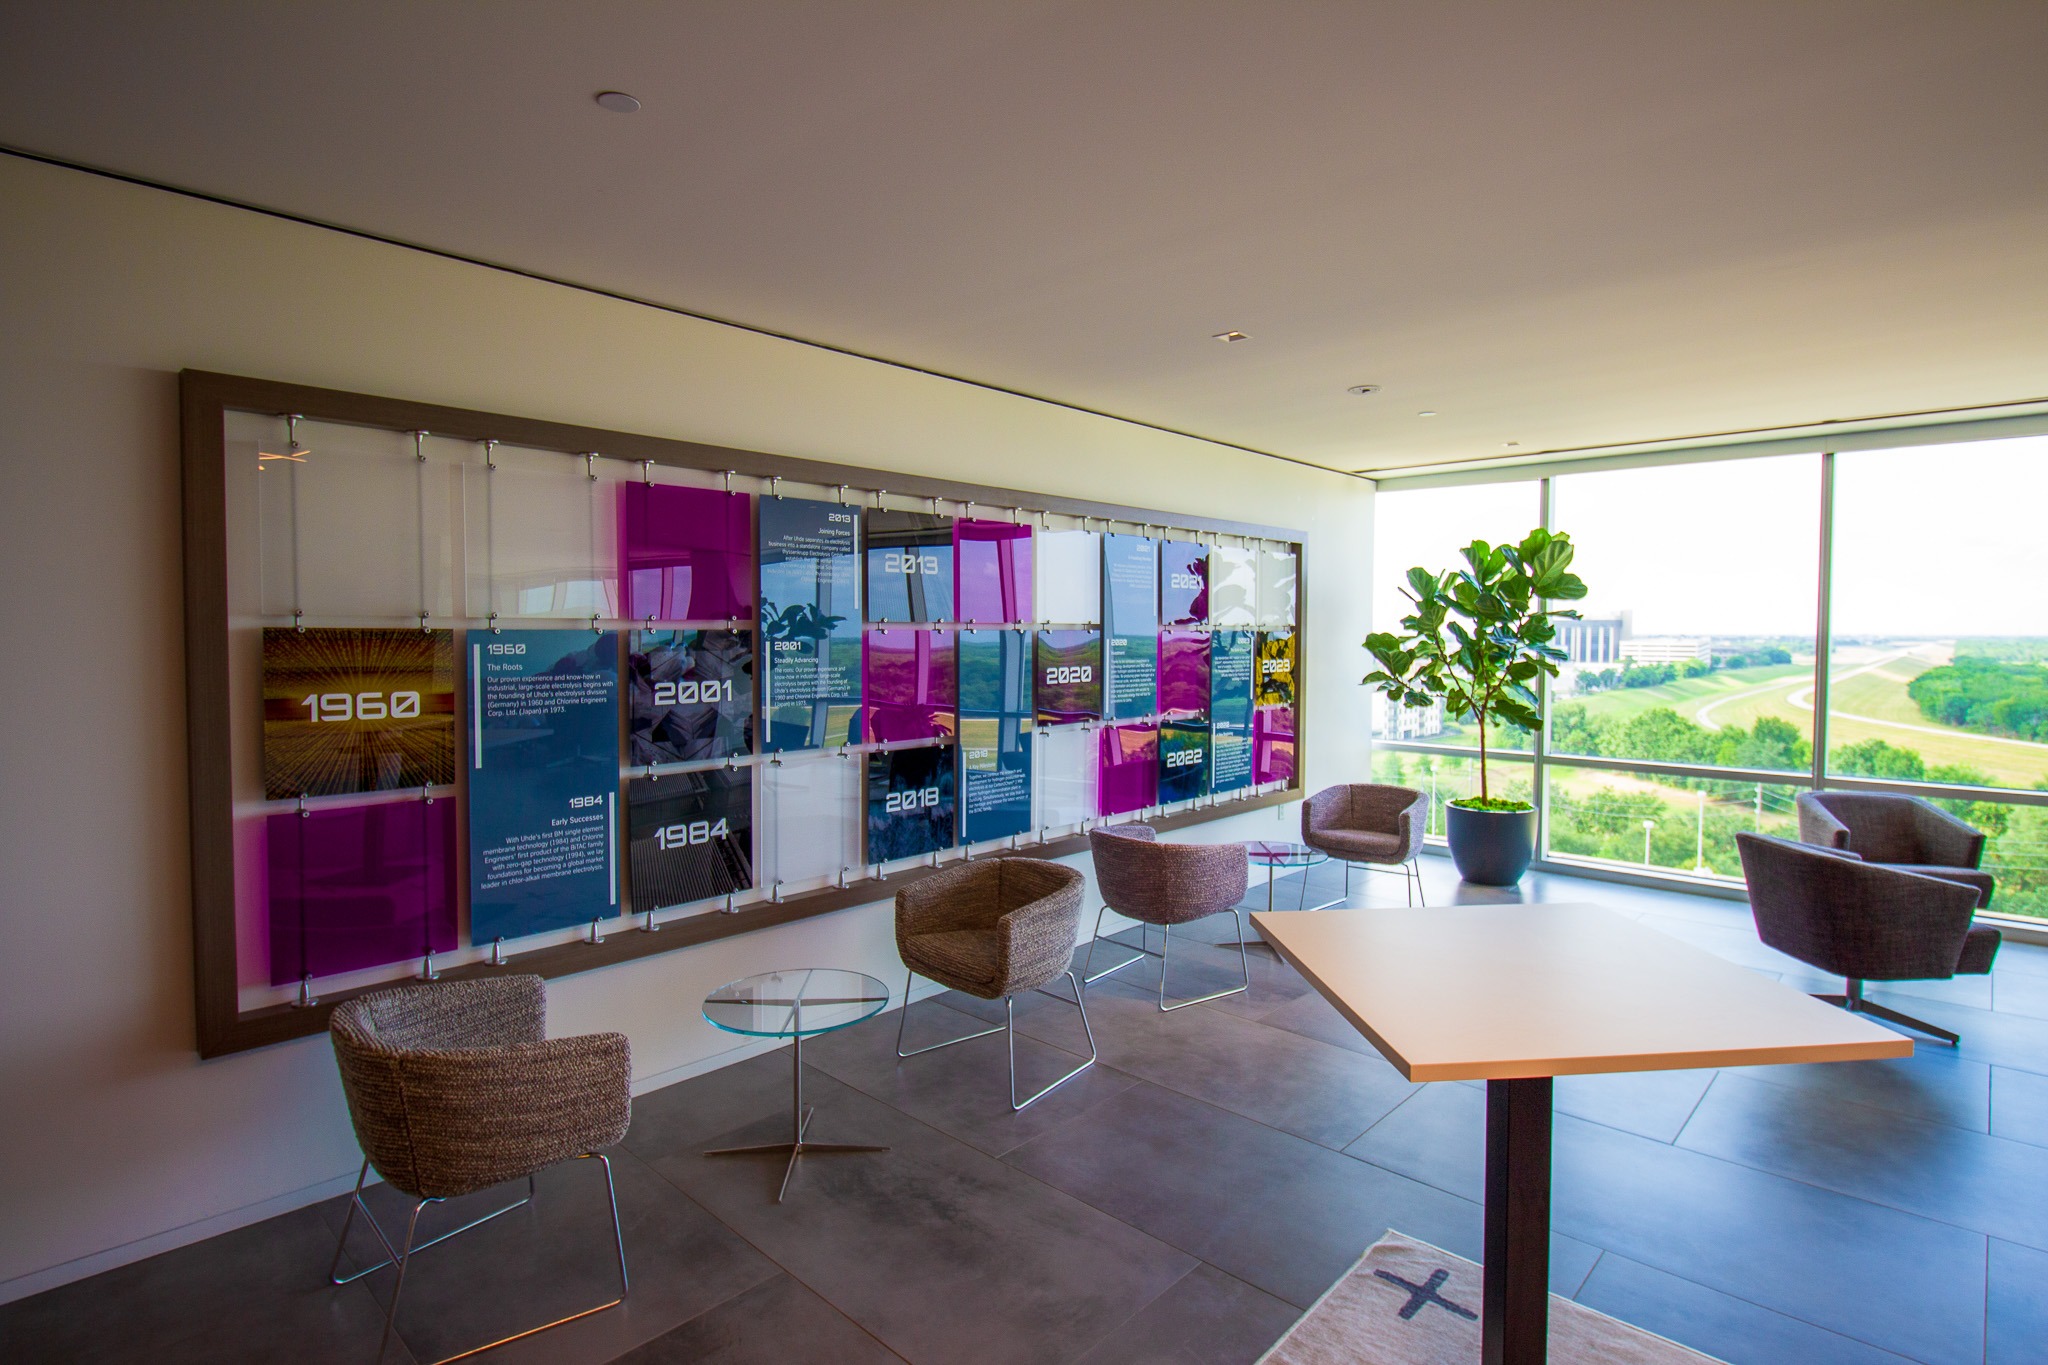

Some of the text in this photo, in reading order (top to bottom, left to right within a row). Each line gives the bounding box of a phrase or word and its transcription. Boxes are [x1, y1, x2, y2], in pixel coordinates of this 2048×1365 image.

[828, 513, 851, 523] 2013
[818, 527, 850, 537] Joining Forces
[885, 553, 939, 575] 2013
[487, 644, 526, 655] 1960
[774, 641, 801, 651] 2001
[503, 663, 523, 671] Roots
[1262, 658, 1290, 674] 2023
[1046, 665, 1092, 685] 2020
[518, 683, 550, 691] large-scale
[583, 681, 601, 689] begins
[654, 679, 733, 706] 2001
[301, 690, 421, 723] 1960
[487, 700, 519, 709] (Germany)
[528, 699, 543, 707] 1960
[580, 697, 607, 705] Engineers
[519, 707, 541, 716] (Japan)
[1166, 748, 1203, 769] 2022
[569, 794, 603, 809] 1984
[885, 786, 939, 813] 2018
[551, 814, 604, 827] Early Successes
[505, 836, 520, 844] With
[564, 828, 581, 836] single
[582, 825, 604, 833] element
[653, 817, 730, 850] 1984
[482, 846, 516, 856] membrane
[516, 841, 548, 850] technology
[549, 837, 569, 847] (1984)
[581, 833, 604, 841] Chlorine
[529, 848, 552, 858] product
[487, 870, 522, 880] foundations
[533, 863, 561, 873] becoming
[567, 859, 585, 868] global
[585, 856, 604, 864] market
[492, 863, 505, 871] with
[506, 860, 532, 869] zero-gap
[533, 854, 564, 864] technology
[481, 881, 500, 889] leader
[508, 874, 540, 885] chlor-alkali
[541, 869, 571, 879] membrane
